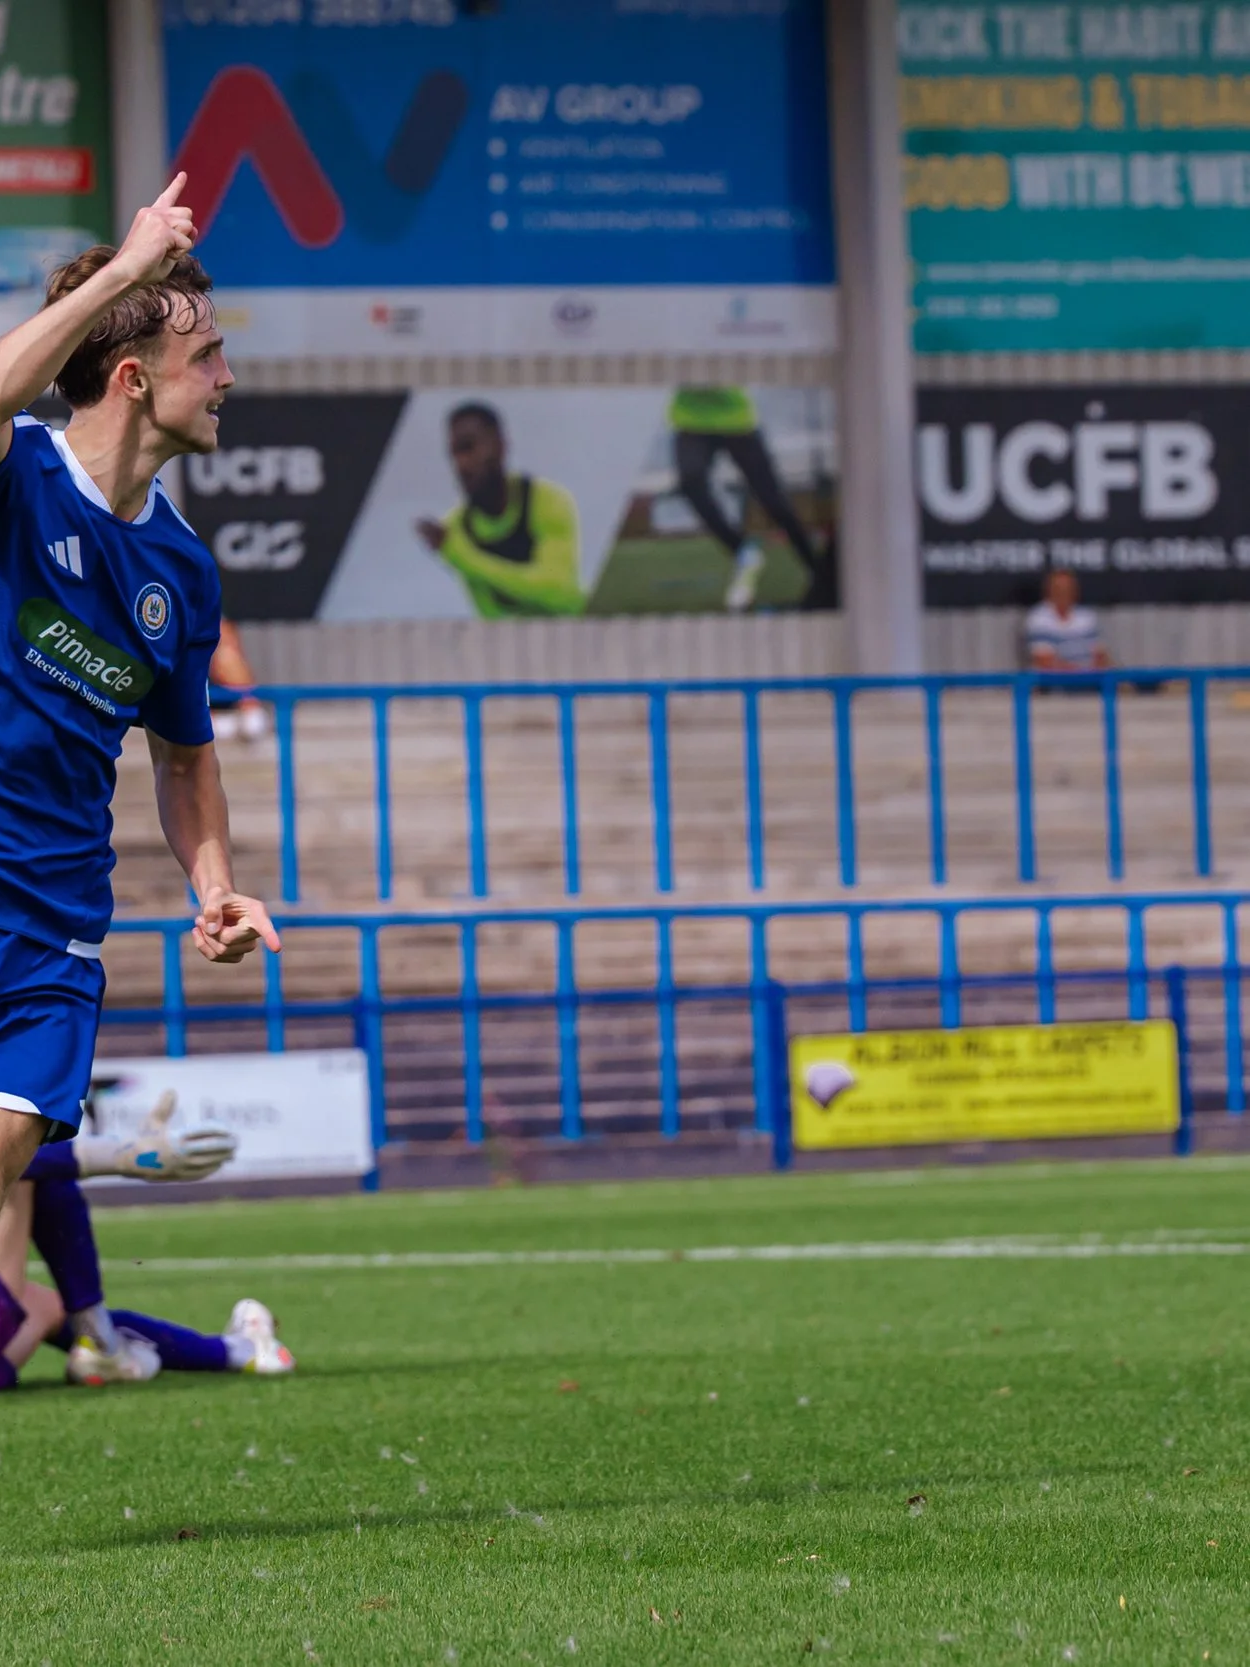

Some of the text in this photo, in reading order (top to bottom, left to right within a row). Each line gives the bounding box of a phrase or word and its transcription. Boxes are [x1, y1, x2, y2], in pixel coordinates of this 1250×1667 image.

[998, 5, 1072, 59] THE
[489, 84, 702, 125] AV GROUP
[1014, 154, 1123, 208] WITH
[189, 447, 323, 495] UCFB
[918, 420, 1220, 524] UCFB
[25, 647, 117, 716] Electrical Supplies
[38, 620, 133, 691] Pinnacle
